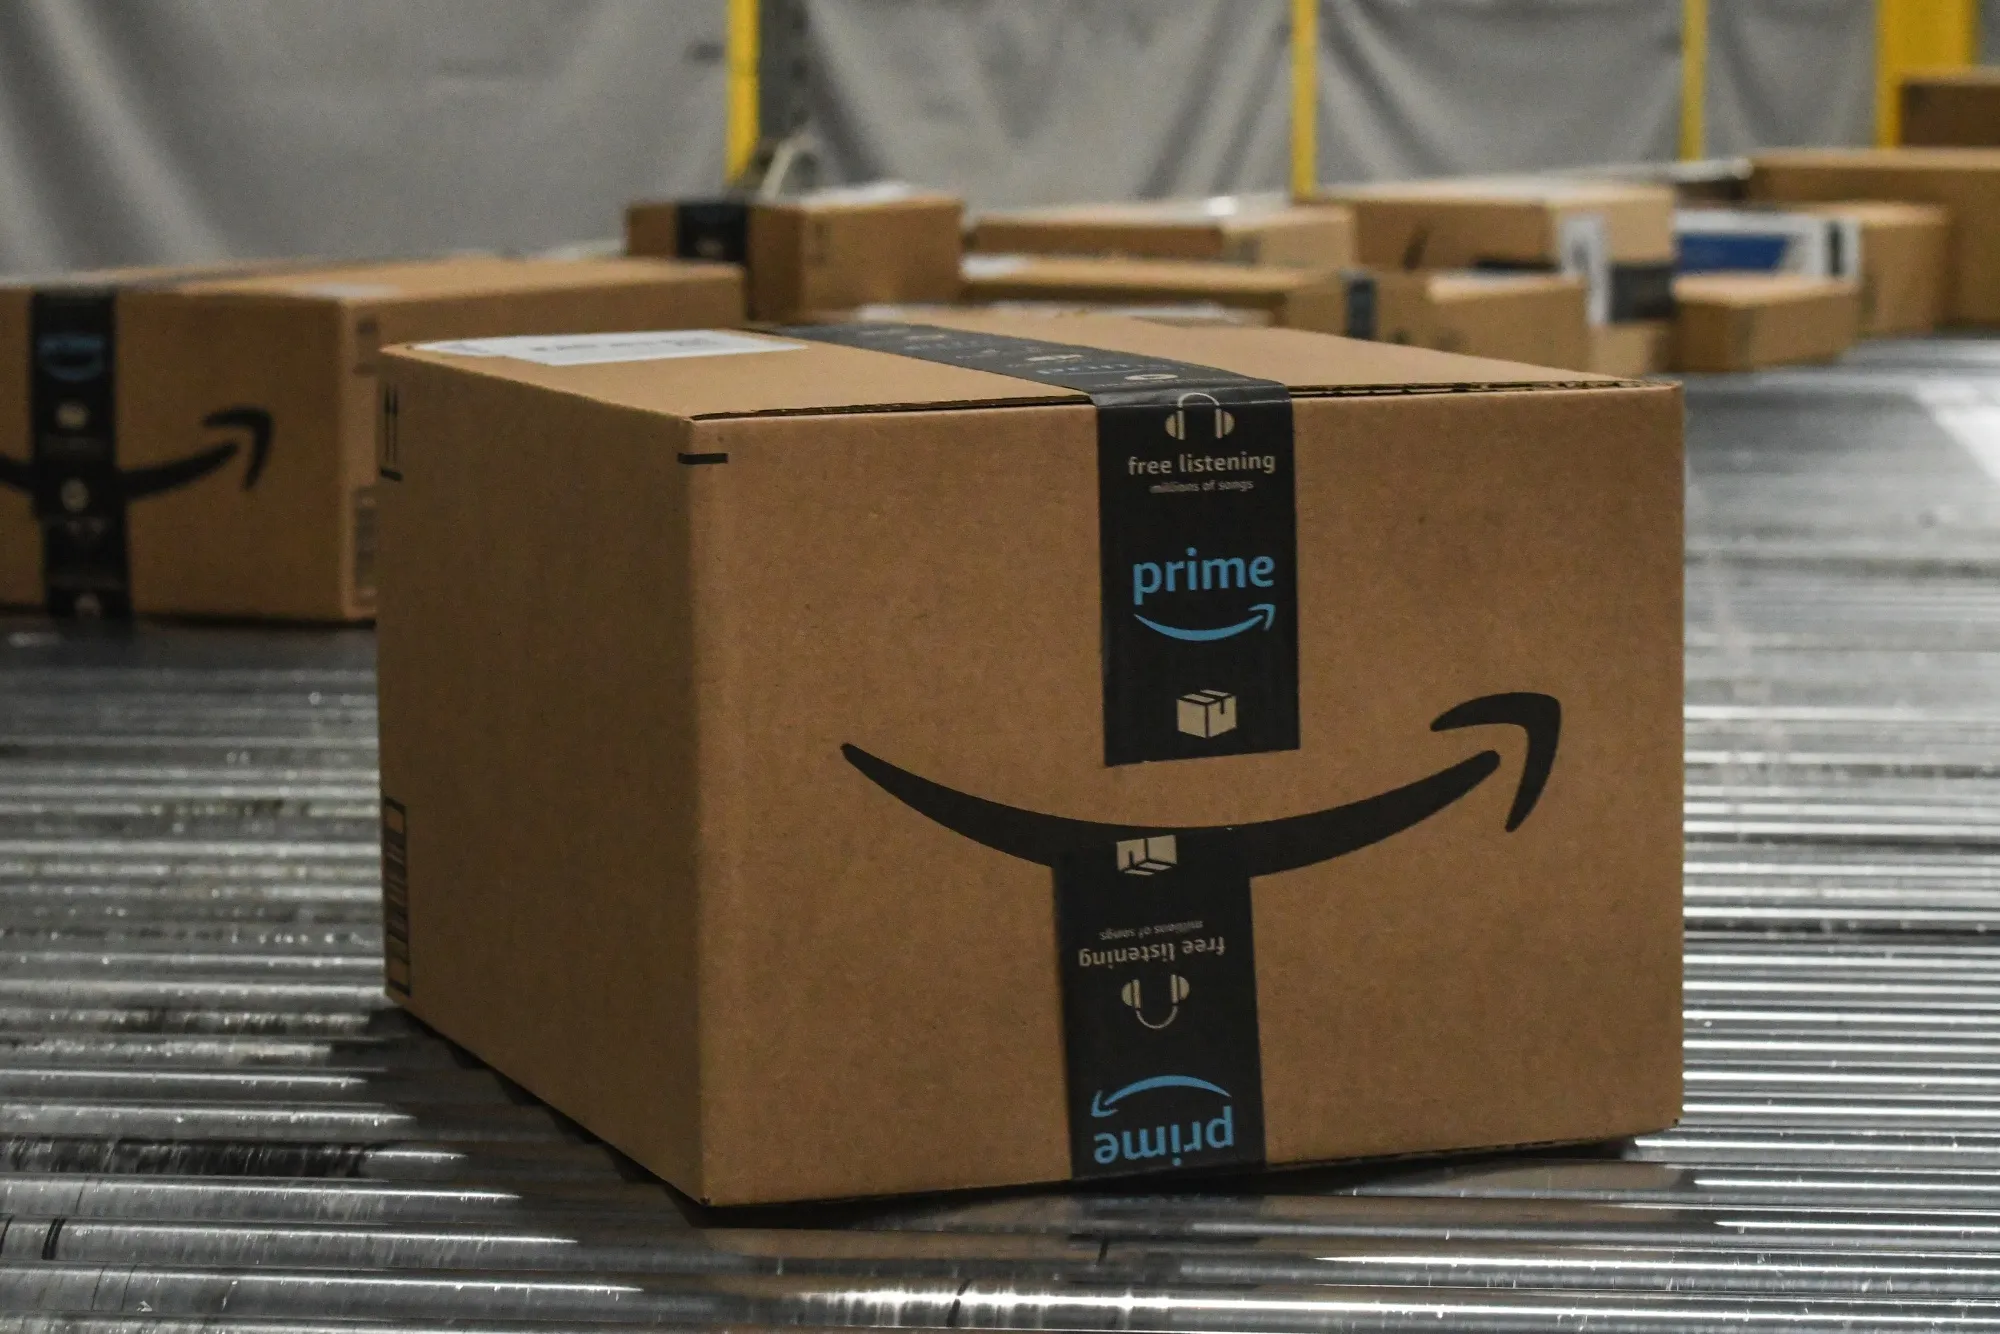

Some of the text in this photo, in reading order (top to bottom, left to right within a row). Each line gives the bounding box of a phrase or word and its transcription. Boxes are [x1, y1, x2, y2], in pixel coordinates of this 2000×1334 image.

[1128, 451, 1276, 476] free listening
[1202, 480, 1216, 492] of
[1218, 479, 1254, 492] songs
[1133, 547, 1275, 606] prime
[1098, 928, 1136, 942] songs
[1139, 925, 1153, 938] of
[1078, 936, 1226, 969] free listening
[1094, 1106, 1235, 1166] prime
